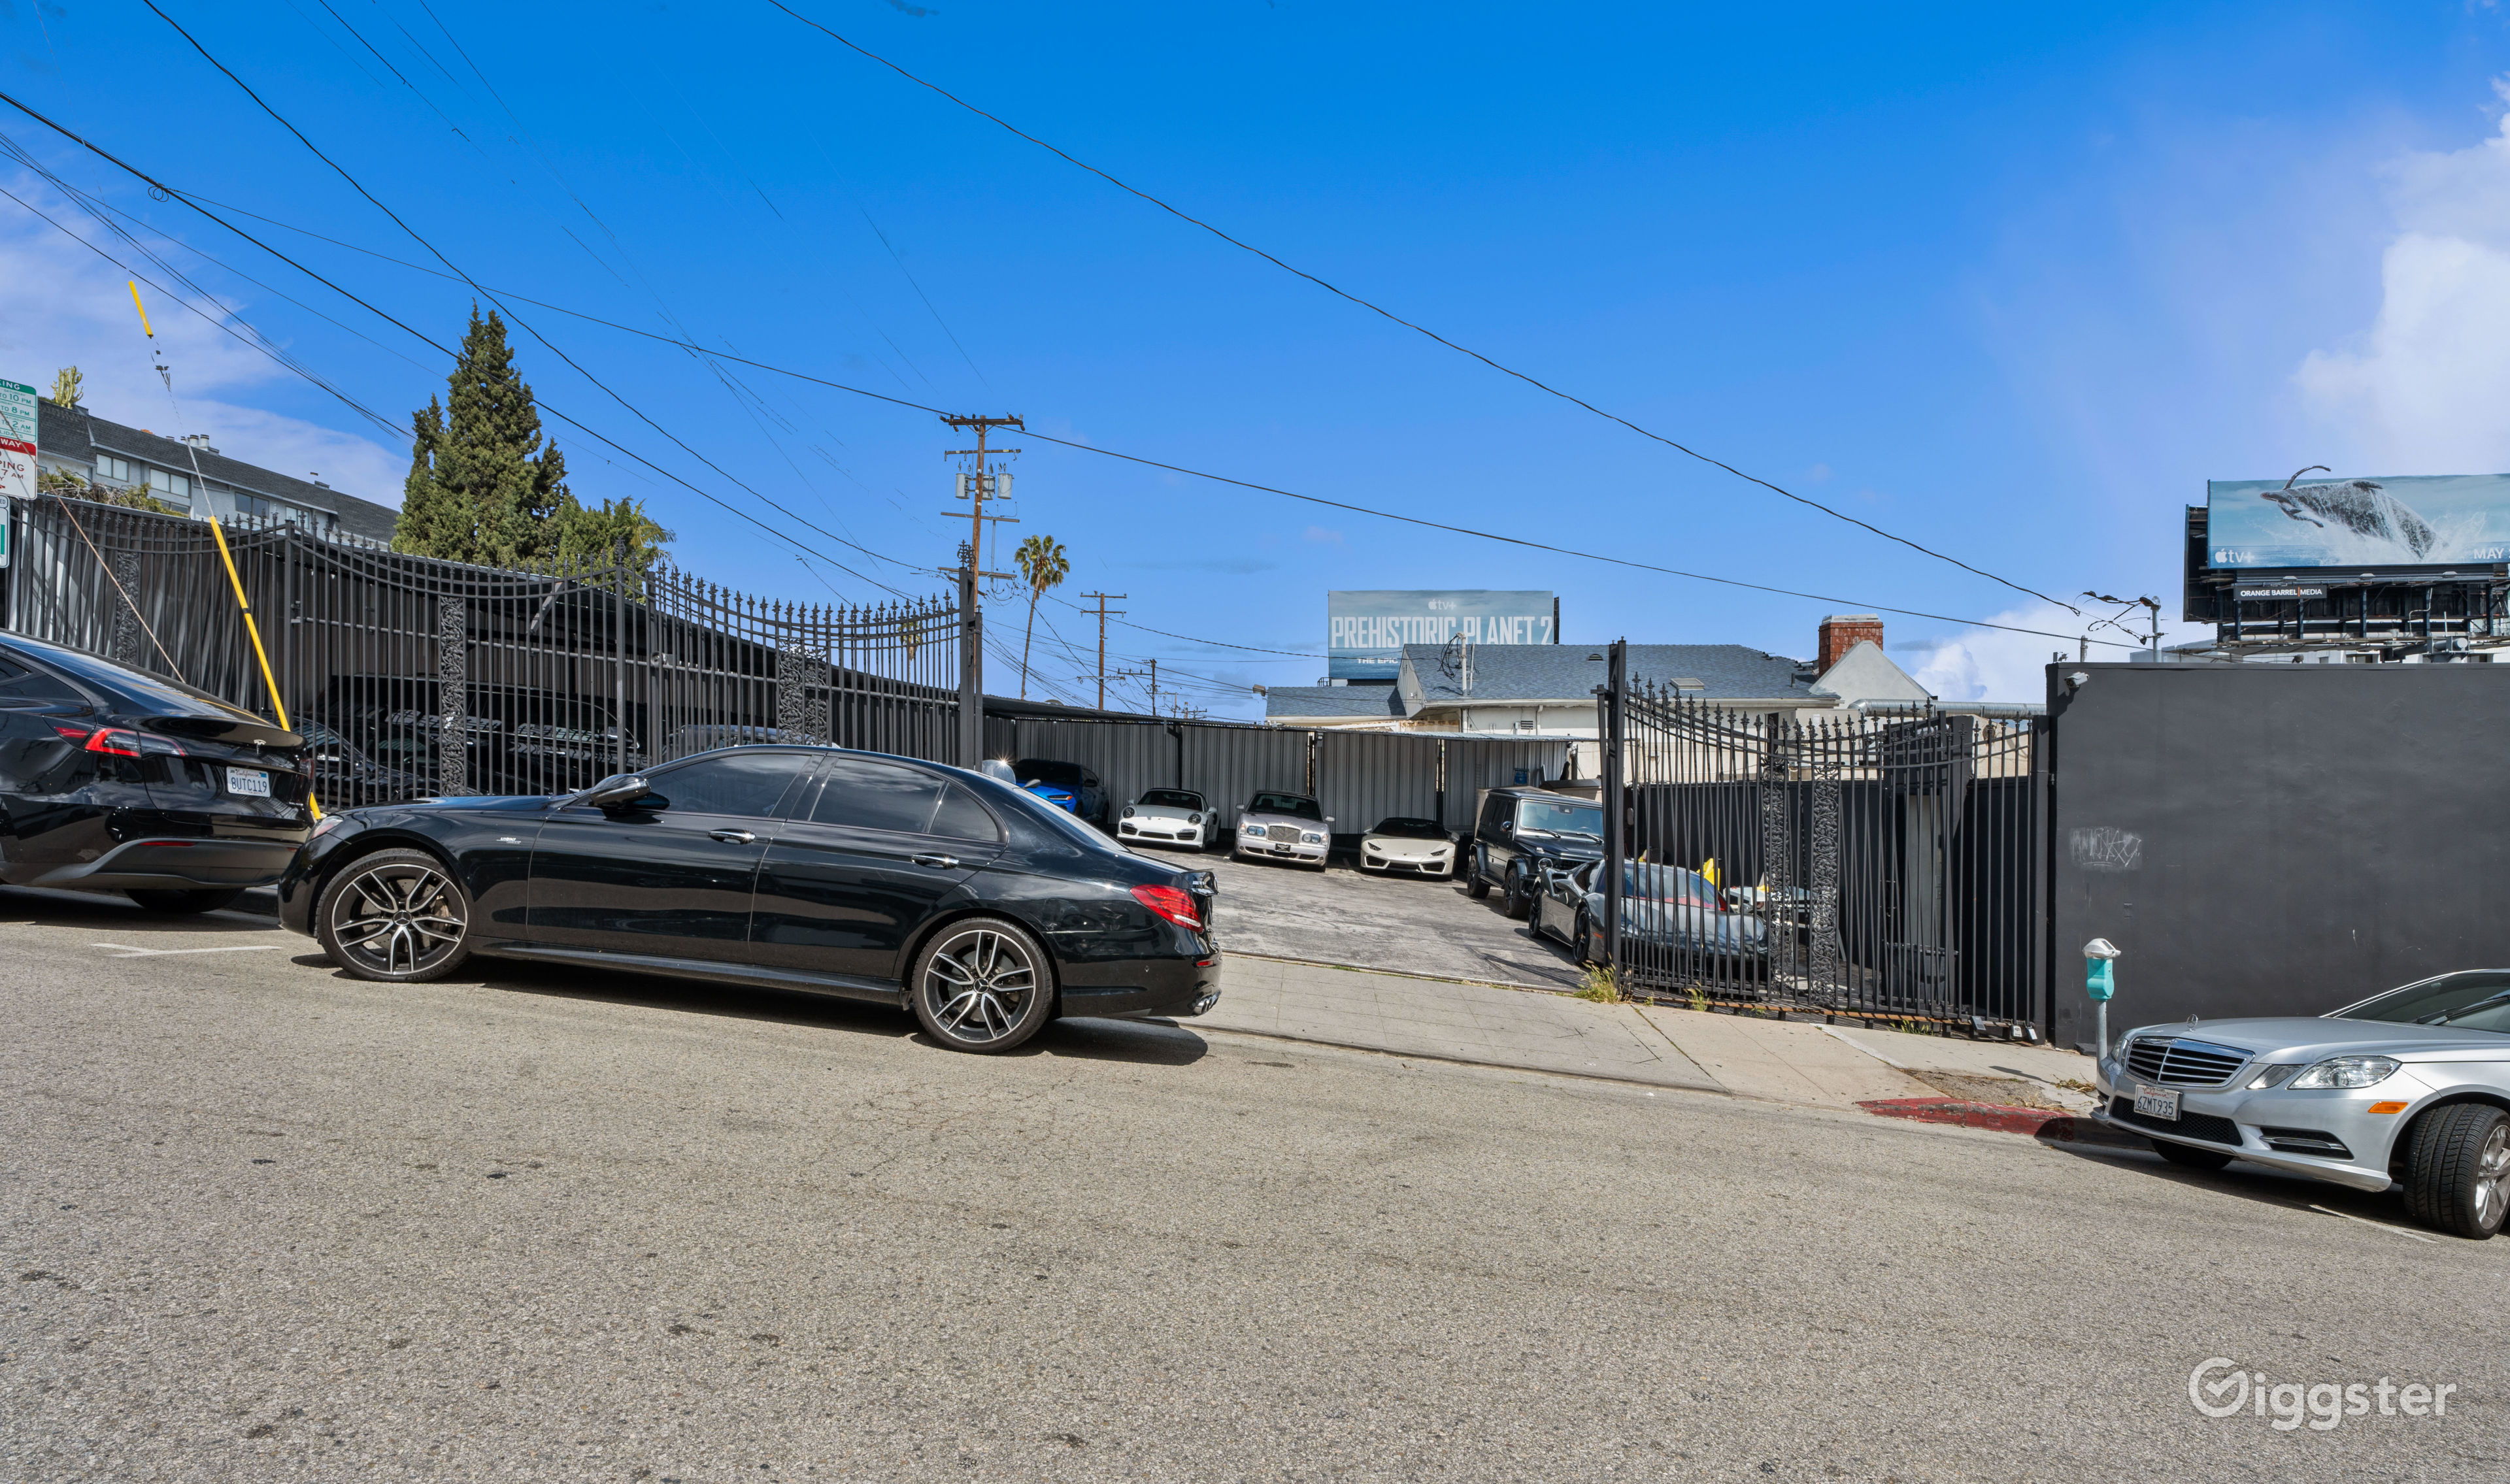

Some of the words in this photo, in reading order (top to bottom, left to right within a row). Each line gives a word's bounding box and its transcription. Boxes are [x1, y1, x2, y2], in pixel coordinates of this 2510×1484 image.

[2473, 548, 2505, 559] MAY
[1331, 616, 1456, 648] PREHISTORIC
[1464, 616, 1535, 645] PLANET
[1540, 616, 1552, 645] 2
[231, 776, 267, 793] 8UTC119
[2137, 1096, 2174, 1115] 6ZMT935
